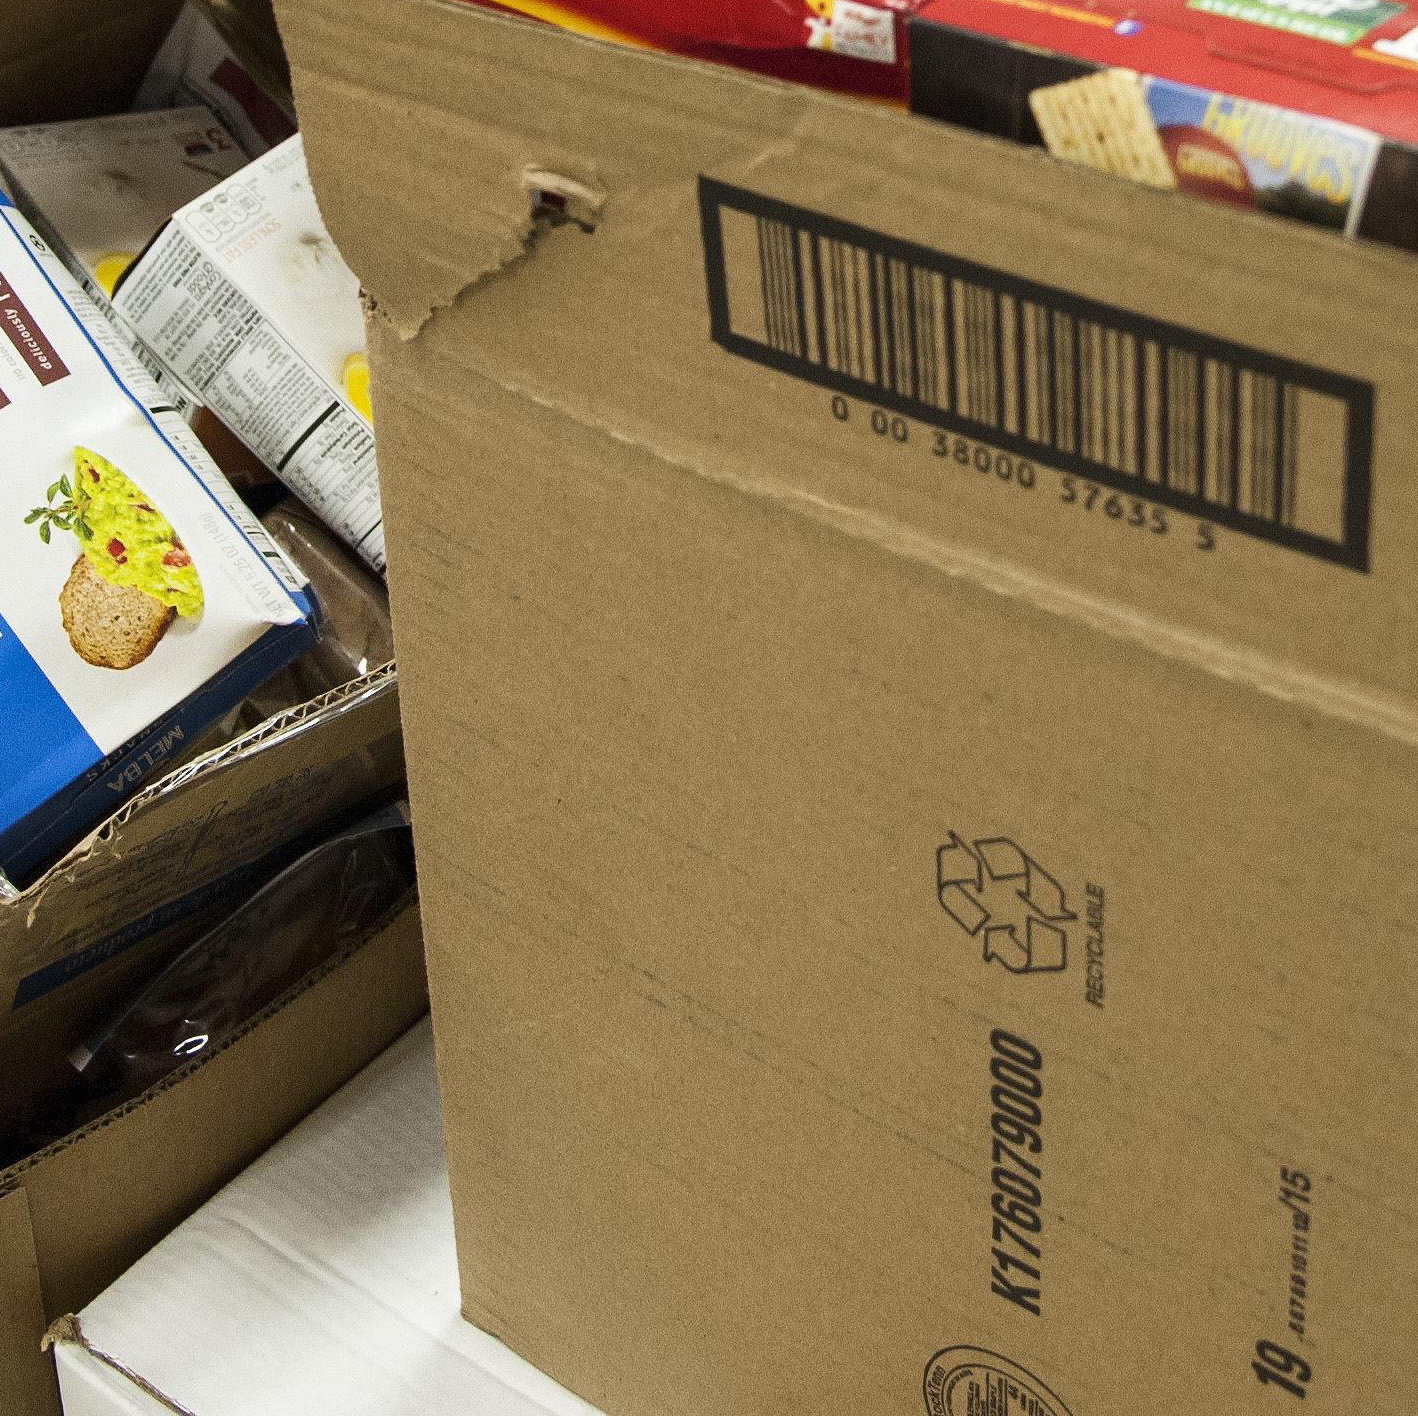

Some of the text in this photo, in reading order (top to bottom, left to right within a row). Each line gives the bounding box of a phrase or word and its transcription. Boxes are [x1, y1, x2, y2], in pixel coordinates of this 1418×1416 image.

[4, 307, 53, 372] deliciously
[831, 395, 1217, 552] 0 00 38000 57635 5
[104, 722, 187, 796] MELBA
[1083, 882, 1108, 1008] RECYCLABLE
[989, 1026, 1044, 1317] K176079000
[1251, 1339, 1313, 1400] 19
